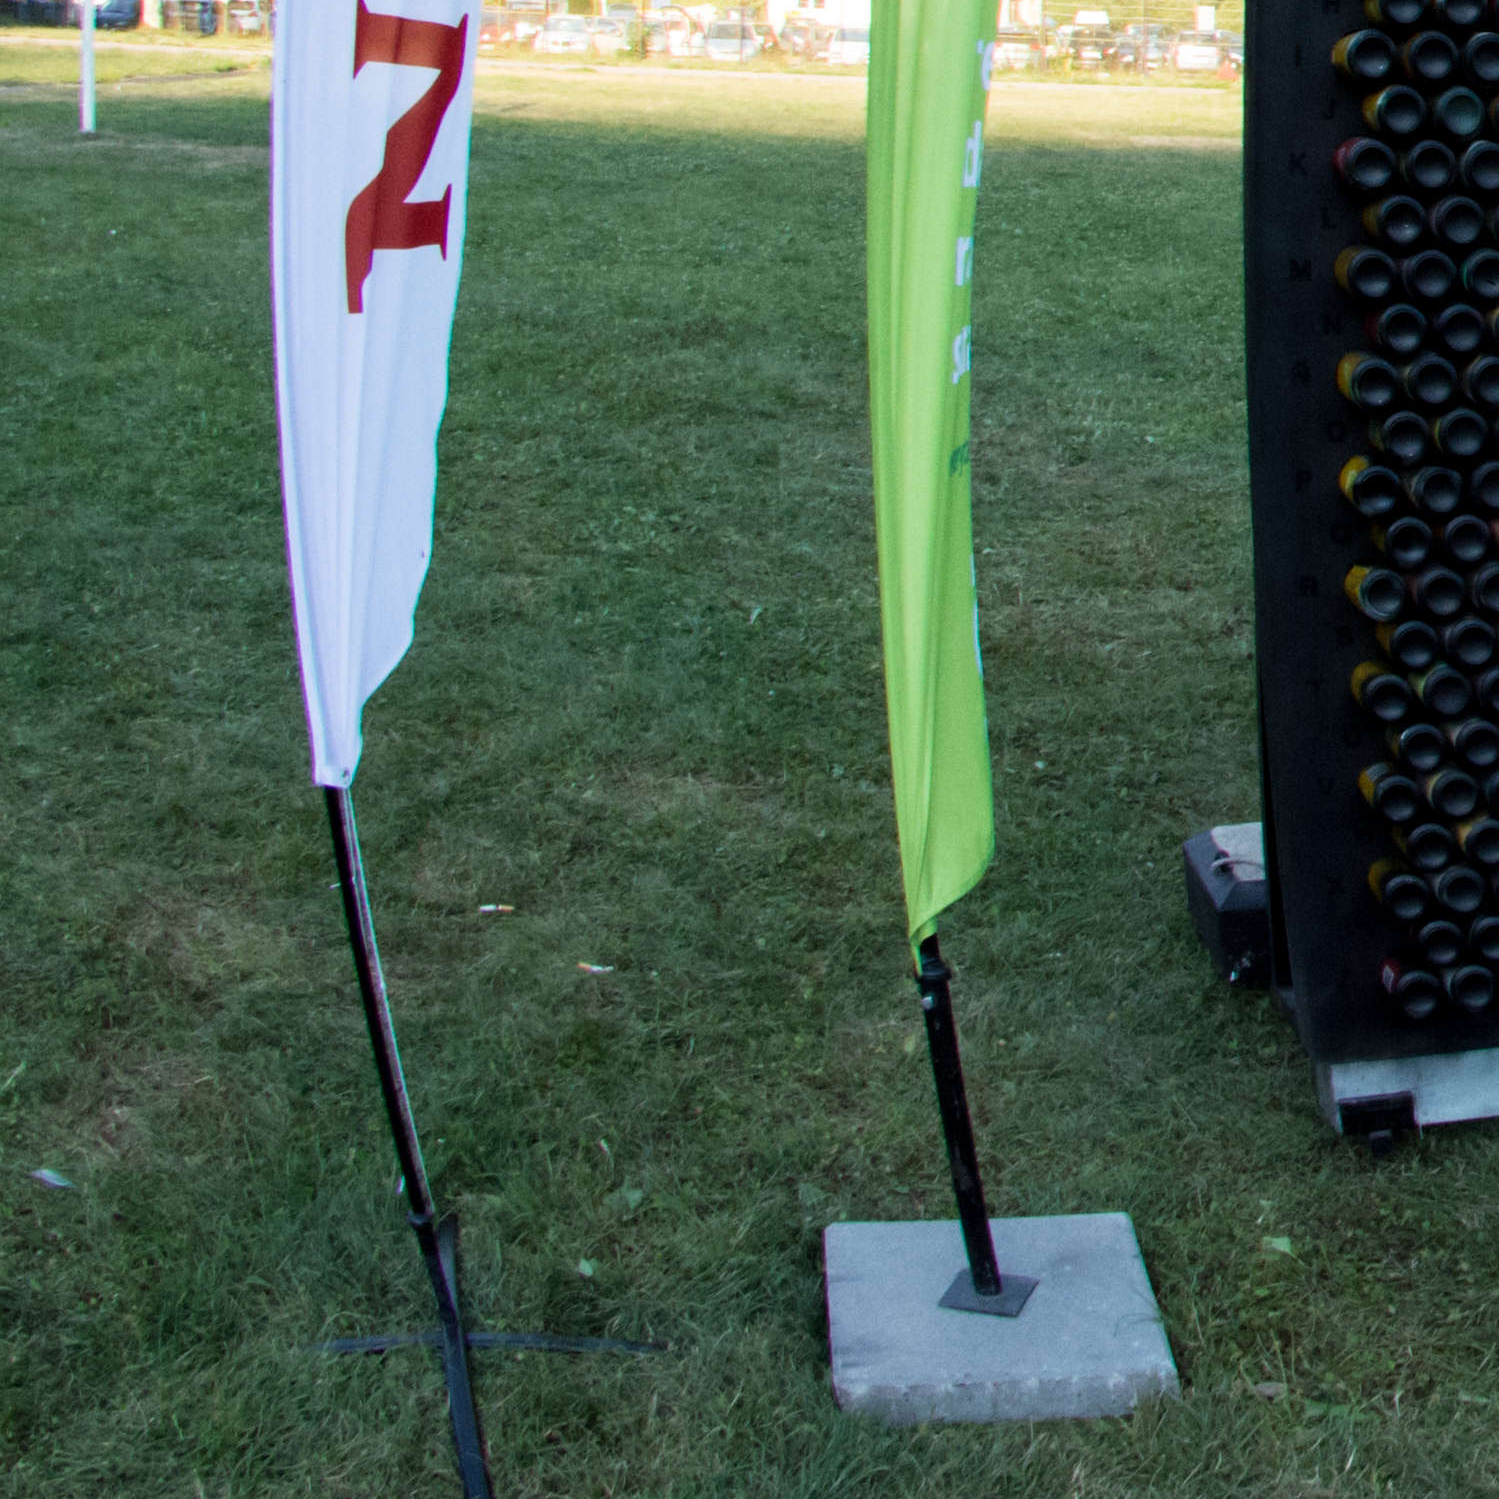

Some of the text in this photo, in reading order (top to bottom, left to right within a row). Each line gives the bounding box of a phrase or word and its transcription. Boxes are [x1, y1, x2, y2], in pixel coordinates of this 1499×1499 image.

[1294, 44, 1301, 67] I
[1323, 100, 1335, 120] J
[1289, 152, 1308, 175] K
[1323, 207, 1337, 229] L
[1289, 258, 1312, 281] M
[1324, 313, 1342, 336] N
